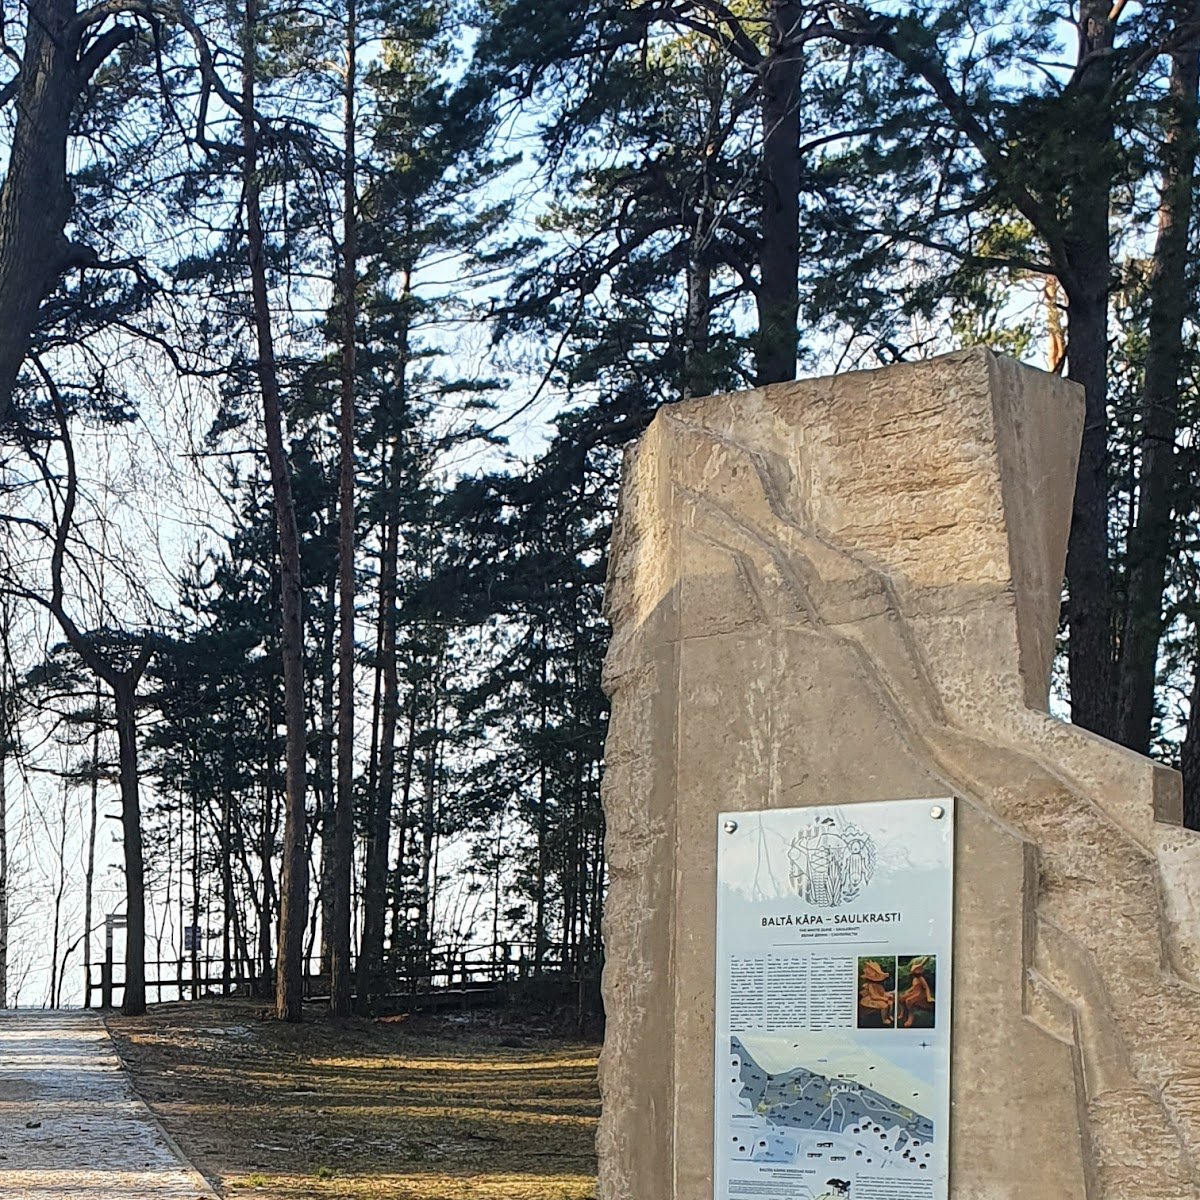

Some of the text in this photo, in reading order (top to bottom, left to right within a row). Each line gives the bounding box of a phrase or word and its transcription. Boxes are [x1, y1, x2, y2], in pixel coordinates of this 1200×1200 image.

[762, 915, 793, 927] BALTĀ
[795, 914, 823, 925] KĀPA
[834, 913, 901, 924] SAULKRASTI
